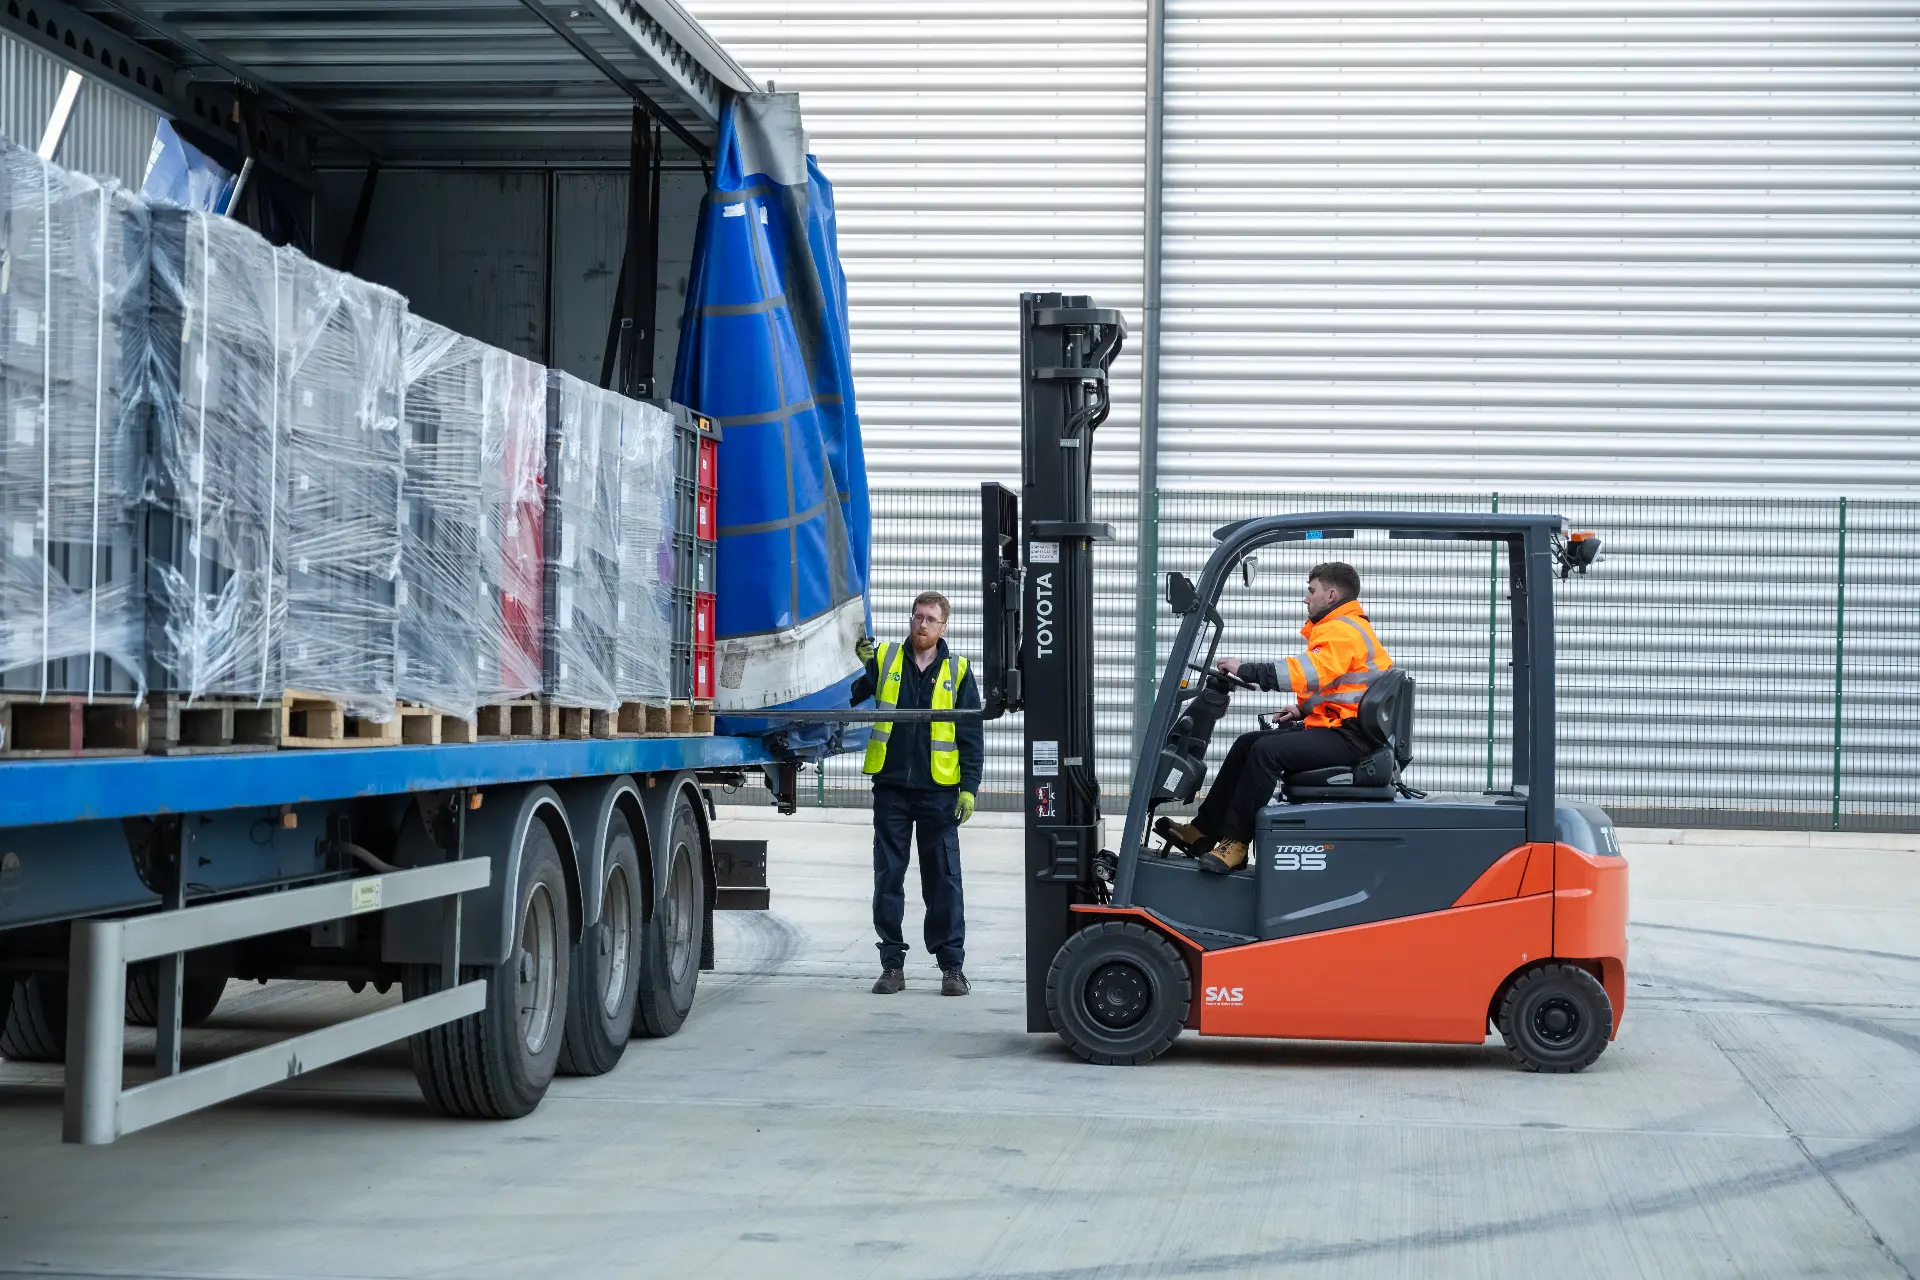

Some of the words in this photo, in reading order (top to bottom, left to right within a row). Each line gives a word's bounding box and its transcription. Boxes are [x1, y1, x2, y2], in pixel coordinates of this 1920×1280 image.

[1036, 572, 1053, 659] TOYOTA
[1273, 853, 1327, 871] 35
[1205, 986, 1244, 1002] SAS
